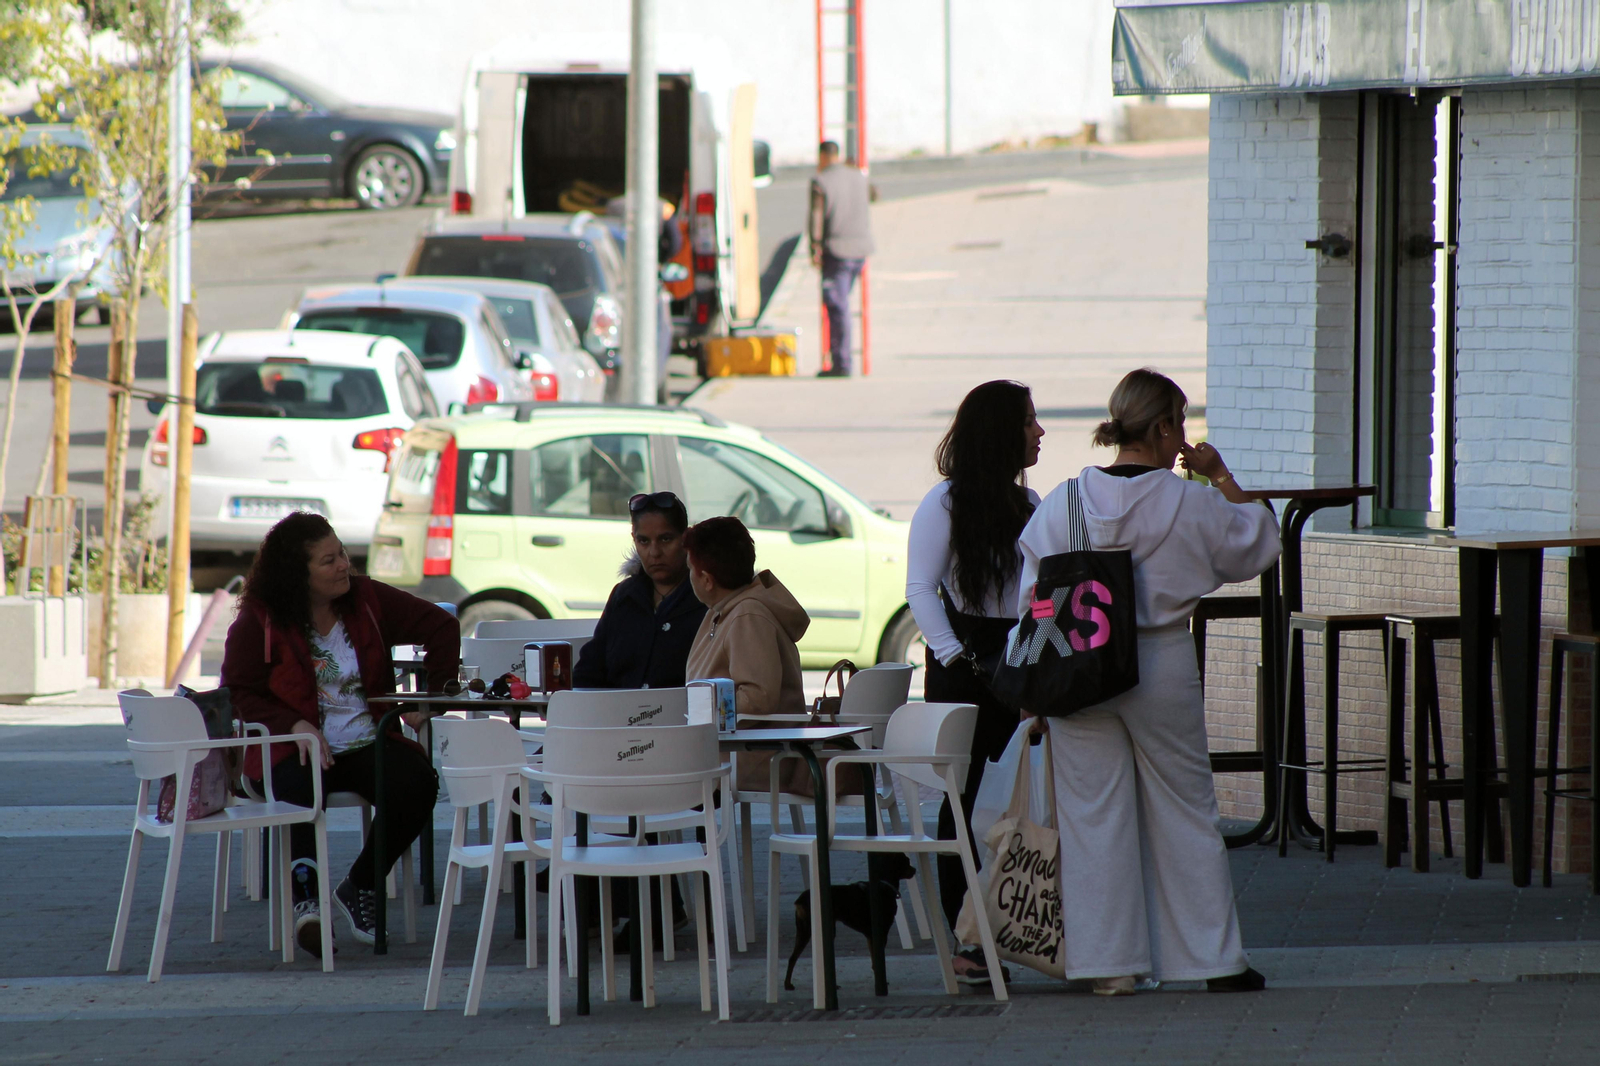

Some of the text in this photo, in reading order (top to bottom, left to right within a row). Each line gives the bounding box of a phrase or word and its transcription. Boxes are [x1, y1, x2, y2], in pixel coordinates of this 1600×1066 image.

[1279, 2, 1331, 88] BAR
[1403, 0, 1431, 83] EL
[617, 740, 654, 761] SanMiguel
[1002, 833, 1056, 884] Smal
[998, 876, 1065, 938] CHANG
[1022, 925, 1044, 941] THE
